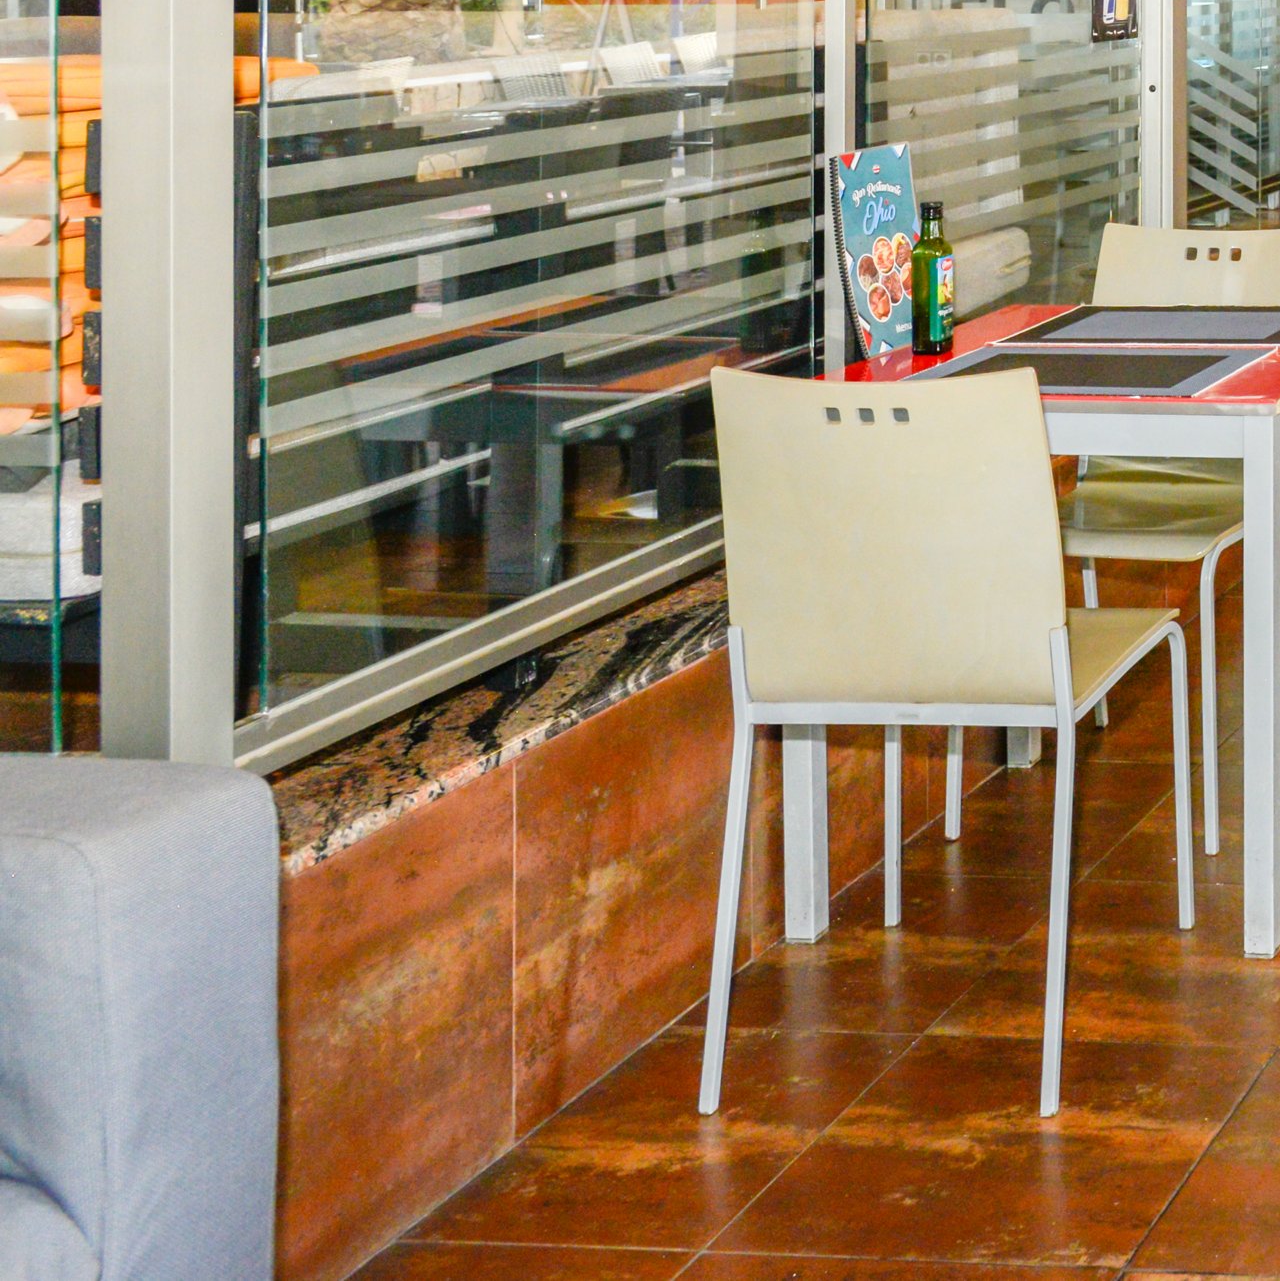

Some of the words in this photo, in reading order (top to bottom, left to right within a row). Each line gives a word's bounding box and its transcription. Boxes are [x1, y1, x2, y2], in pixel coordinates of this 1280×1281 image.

[852, 188, 866, 207] Bar
[866, 180, 903, 199] Restaurante
[863, 197, 897, 236] Ohio
